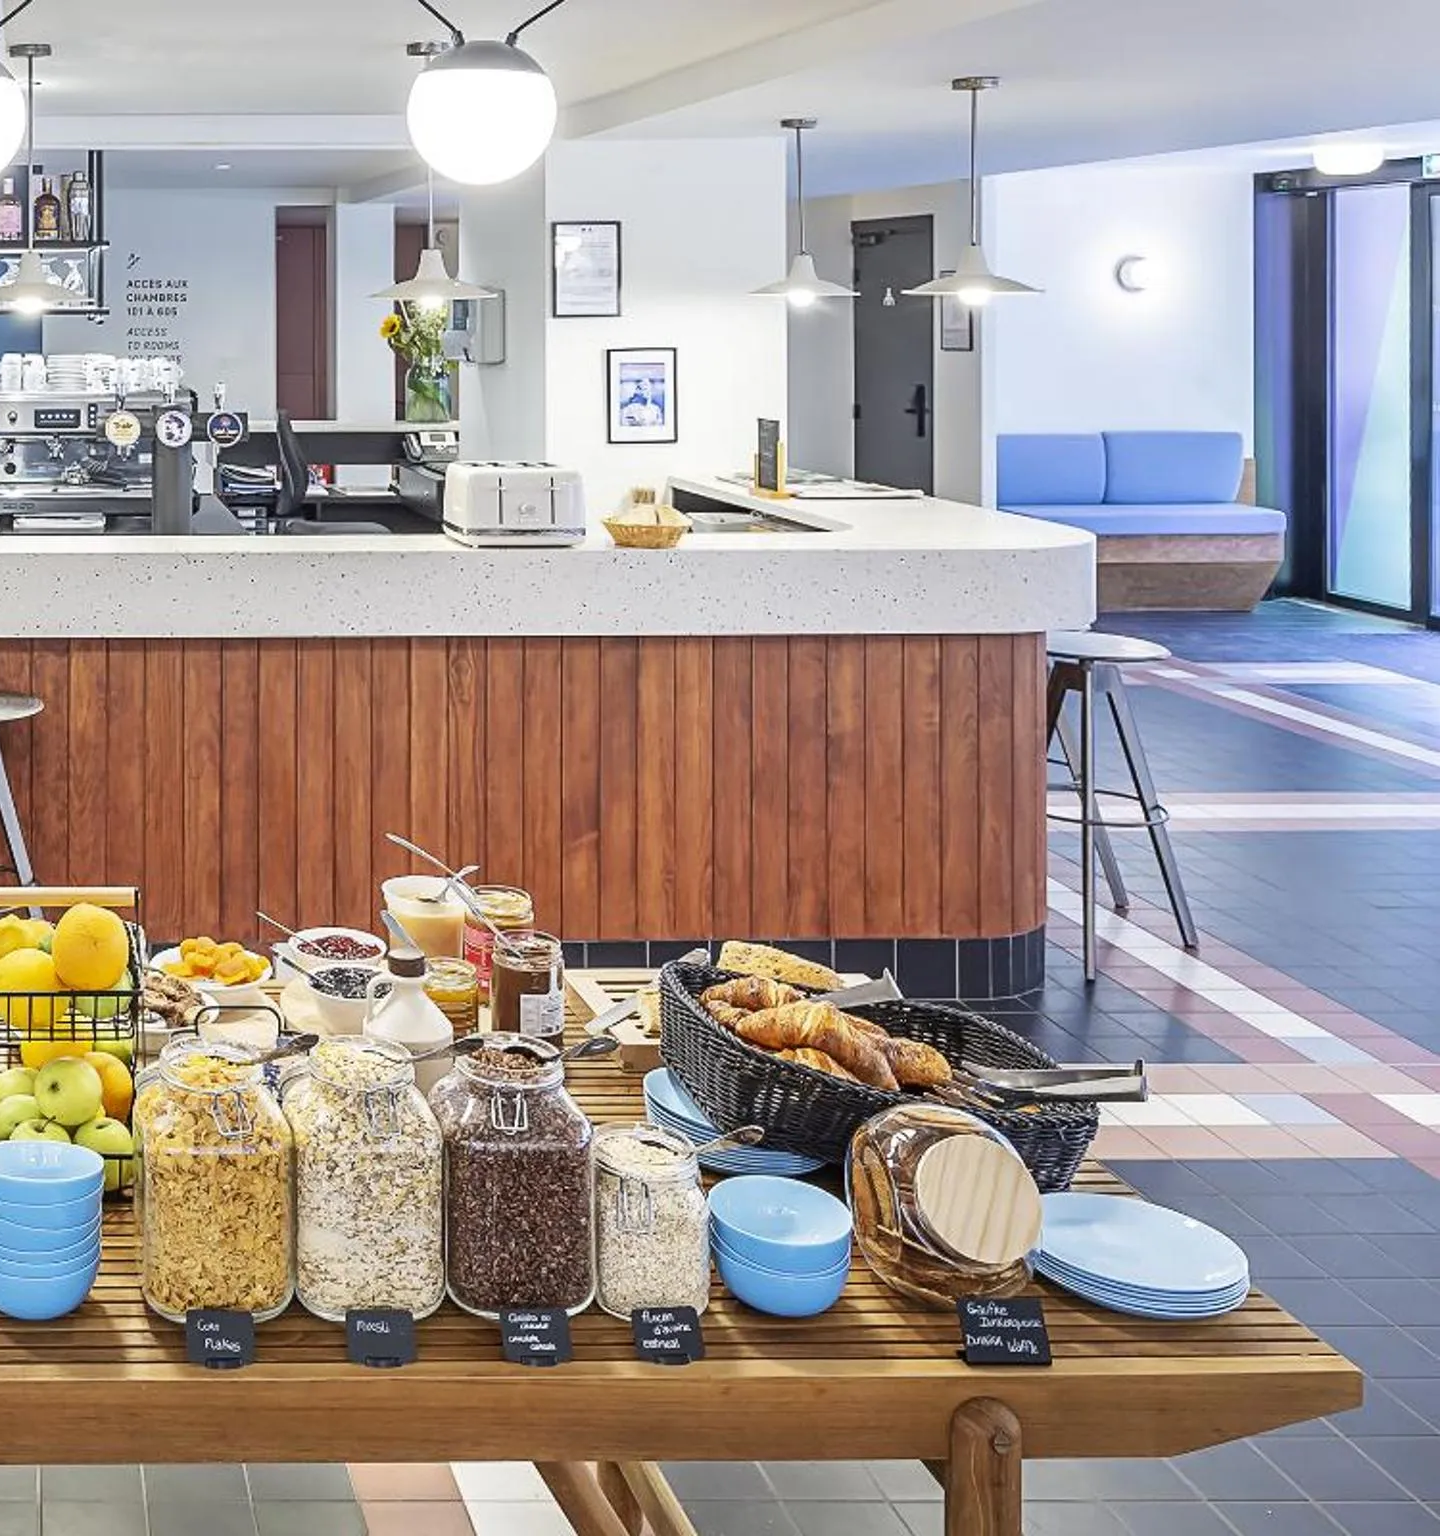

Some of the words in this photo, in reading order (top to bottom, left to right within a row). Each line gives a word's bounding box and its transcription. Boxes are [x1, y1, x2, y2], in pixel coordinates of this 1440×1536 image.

[164, 279, 189, 289] AUX
[126, 293, 187, 302] CHAMBRES
[126, 327, 168, 337] ACCESS
[128, 341, 141, 350] TO
[143, 341, 180, 350] ROOMS
